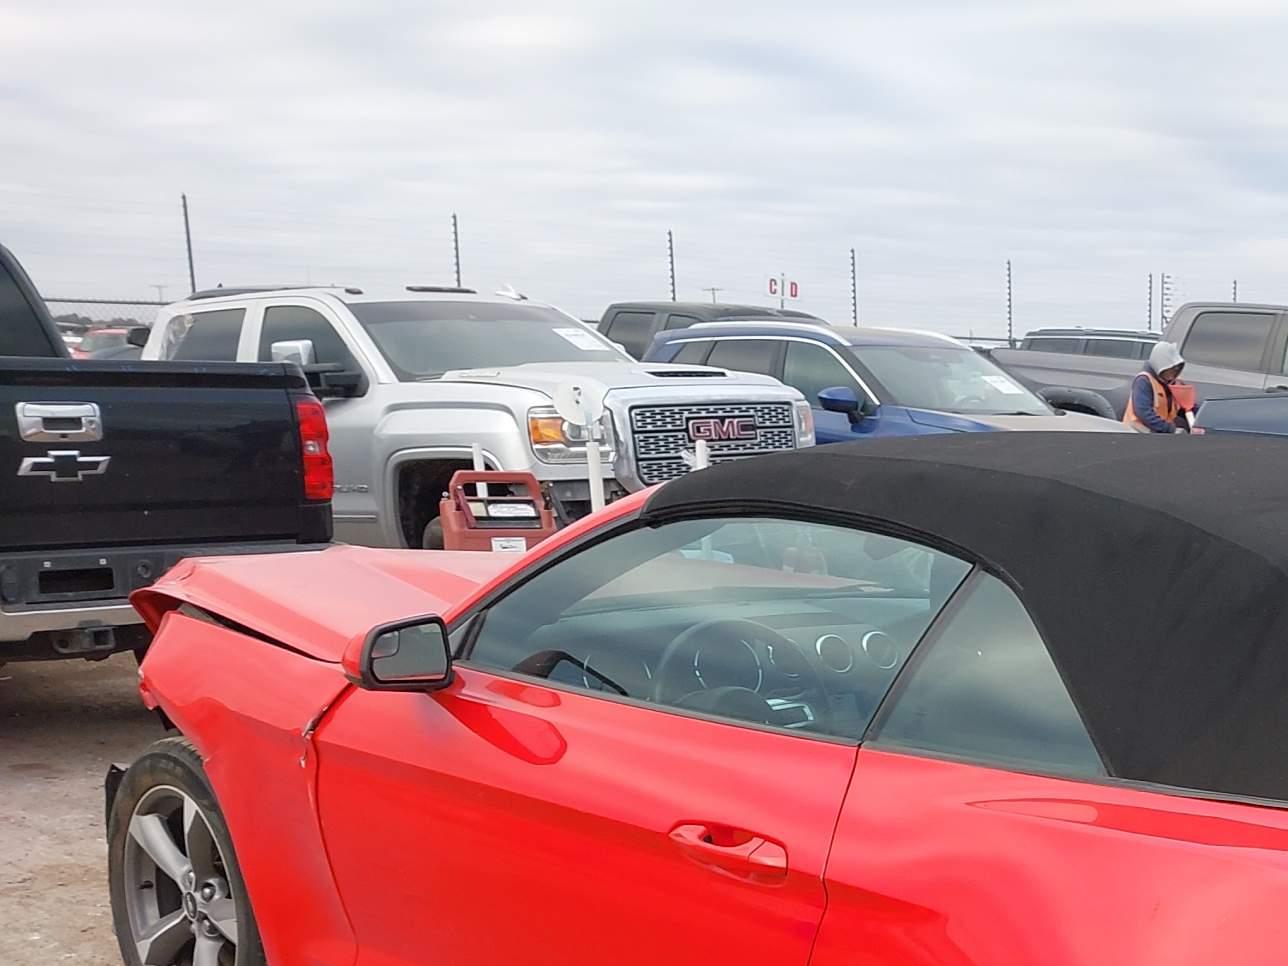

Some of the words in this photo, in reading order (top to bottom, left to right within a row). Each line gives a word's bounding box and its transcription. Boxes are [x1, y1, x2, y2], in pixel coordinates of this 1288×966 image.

[768, 278, 777, 295] C
[789, 282, 798, 298] D
[687, 417, 757, 441] GMC
